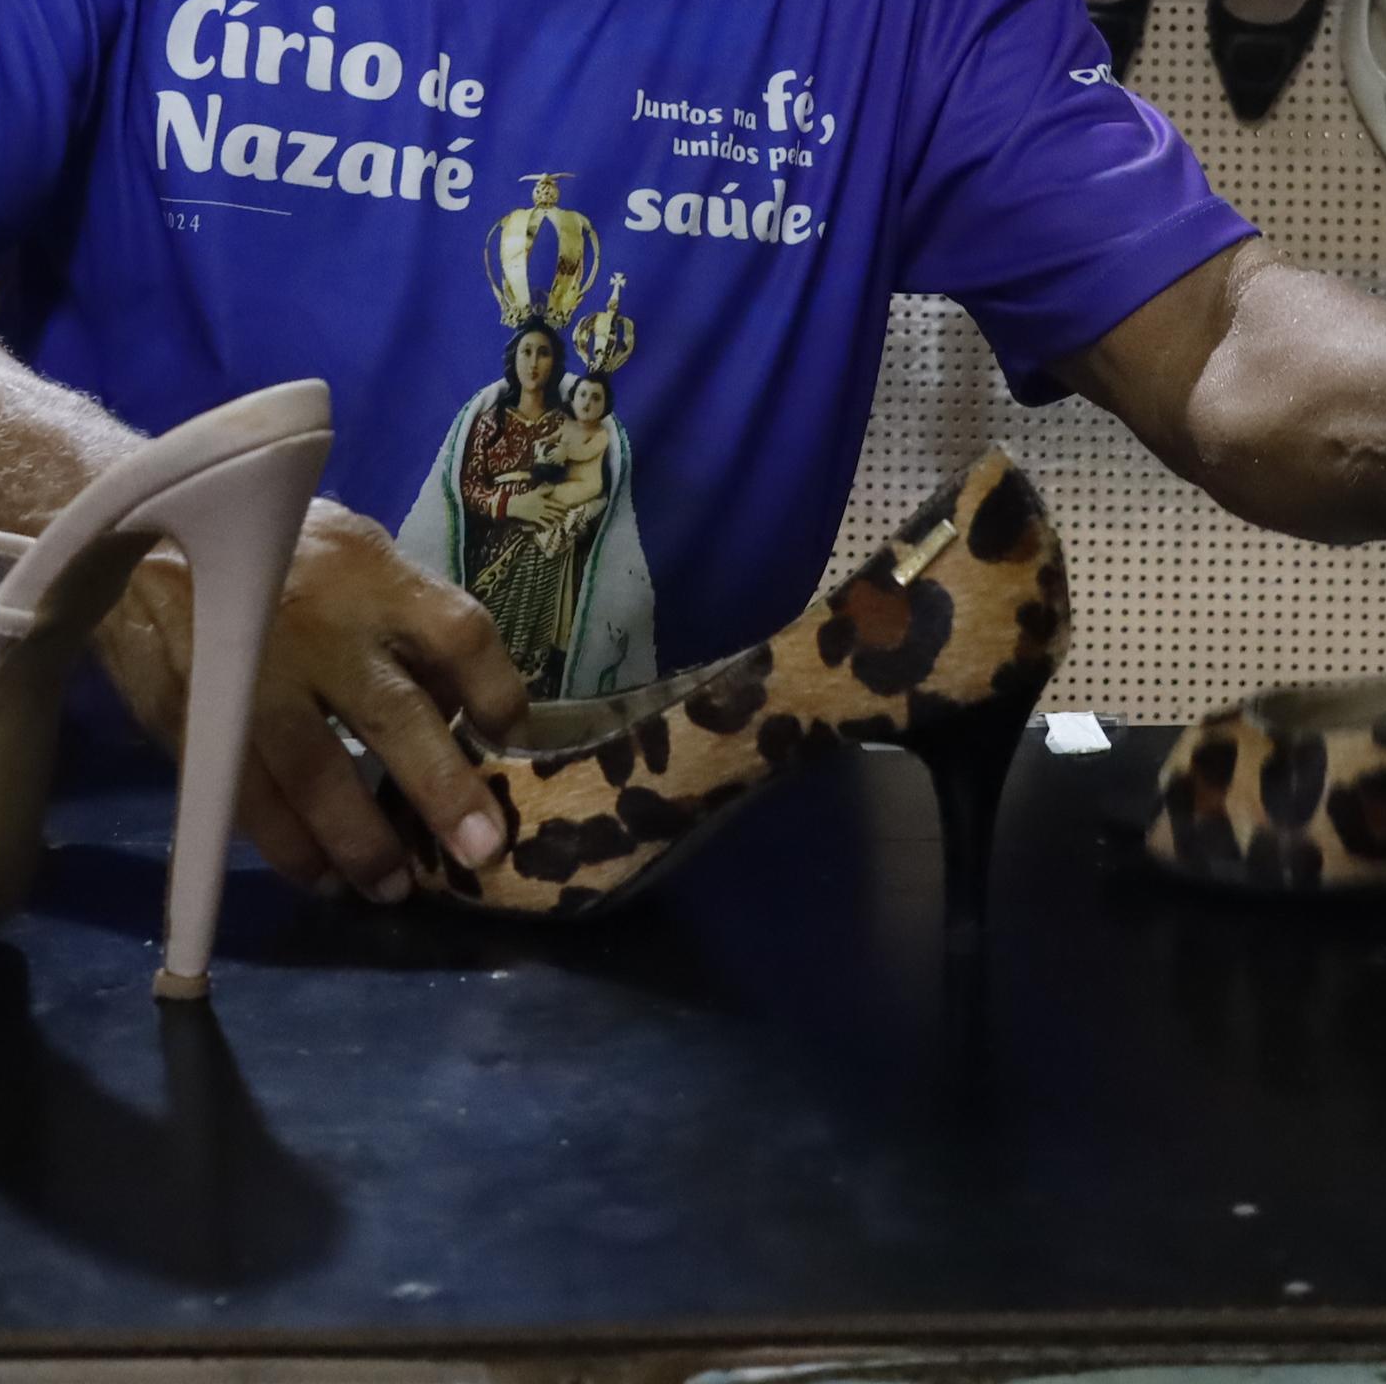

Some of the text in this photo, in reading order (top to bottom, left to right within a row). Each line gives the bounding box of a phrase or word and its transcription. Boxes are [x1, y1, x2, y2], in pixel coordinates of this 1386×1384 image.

[418, 52, 485, 118] de
[632, 88, 723, 125] Juntos
[733, 108, 757, 130] na
[156, 90, 474, 212] Nazaré
[673, 131, 813, 171] unidos pela
[163, 211, 201, 233] 024
